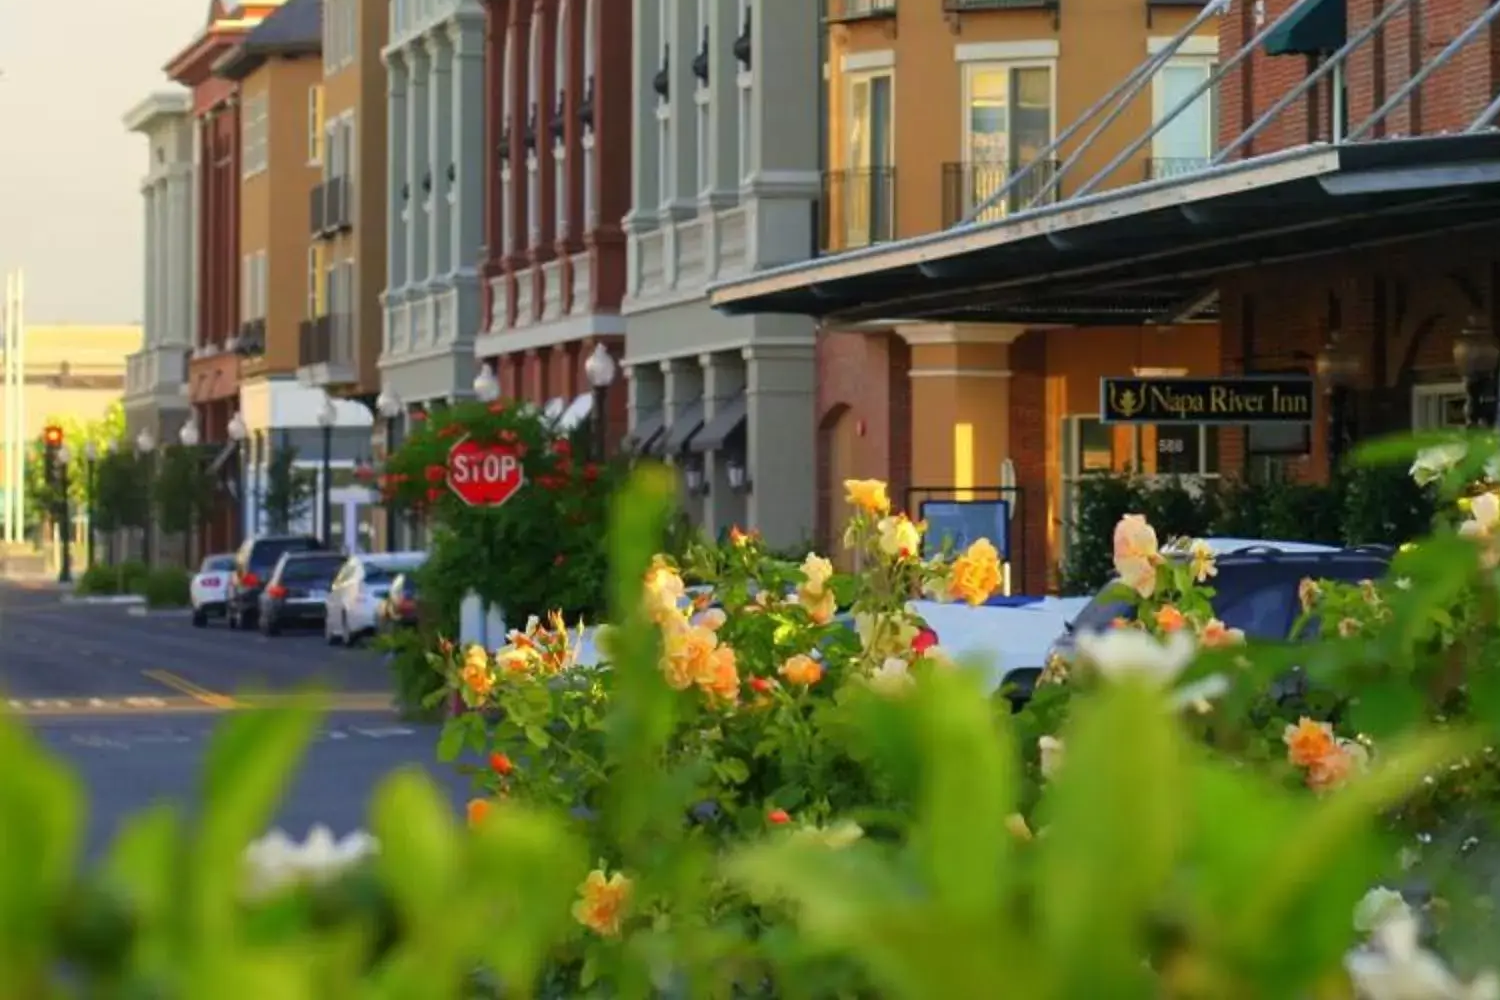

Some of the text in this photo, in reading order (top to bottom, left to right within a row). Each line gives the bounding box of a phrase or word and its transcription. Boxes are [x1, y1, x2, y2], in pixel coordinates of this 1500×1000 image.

[1150, 384, 1308, 419] Napa River Inn
[453, 454, 516, 483] STOP
